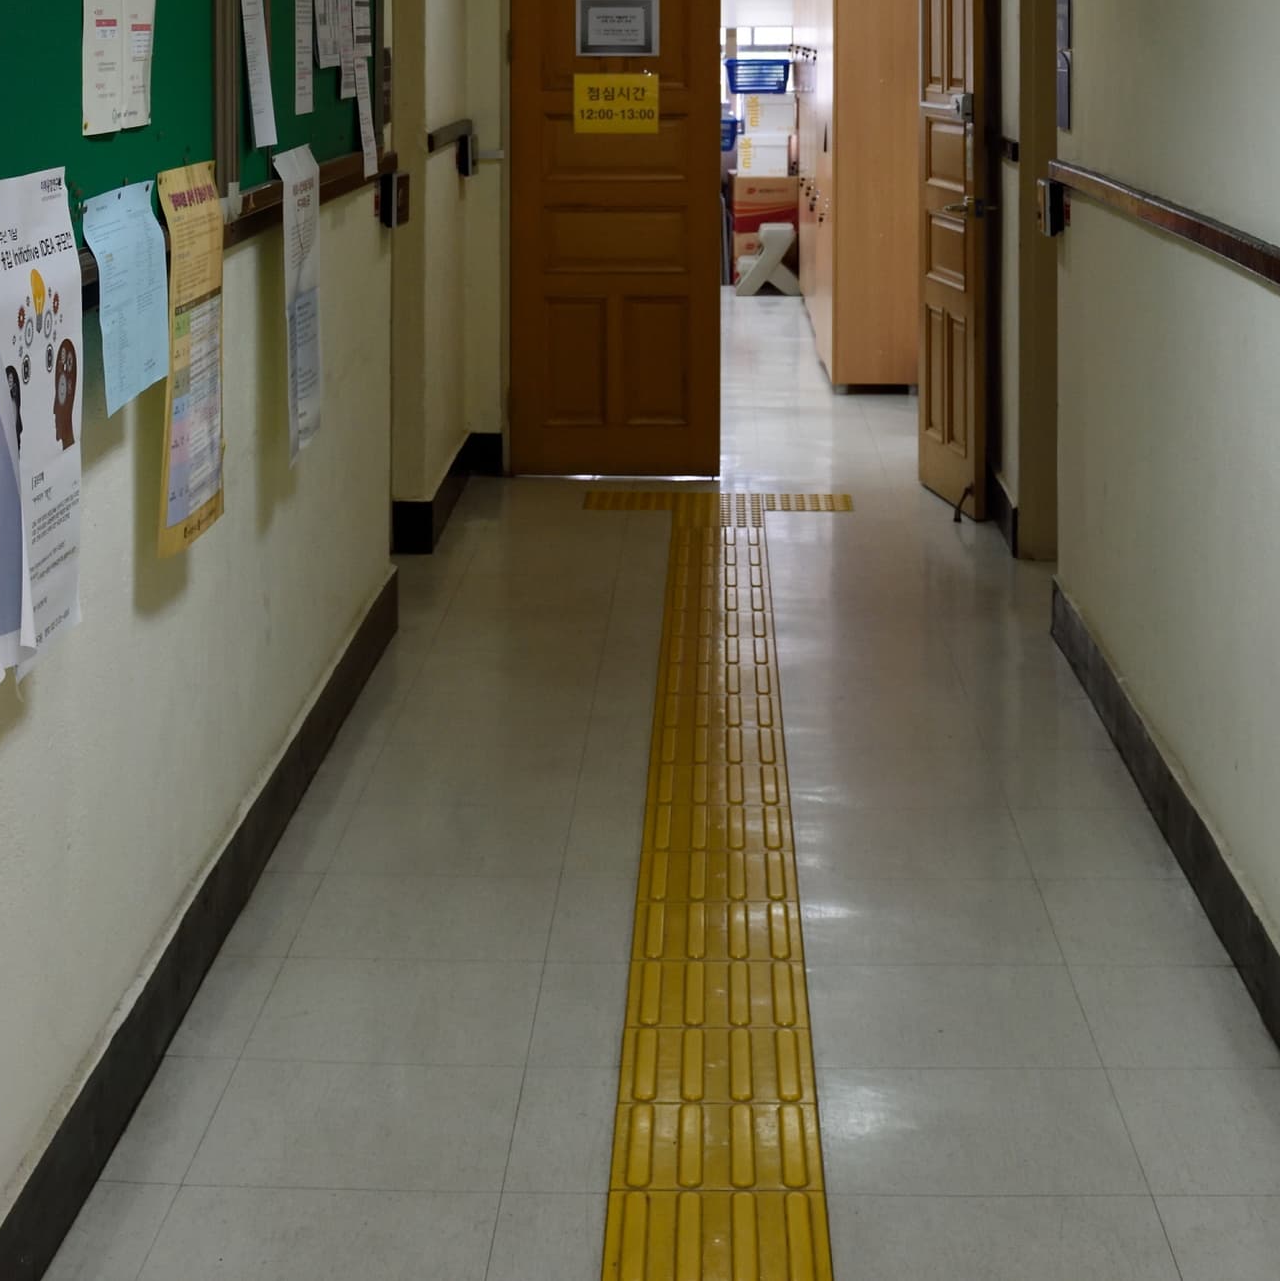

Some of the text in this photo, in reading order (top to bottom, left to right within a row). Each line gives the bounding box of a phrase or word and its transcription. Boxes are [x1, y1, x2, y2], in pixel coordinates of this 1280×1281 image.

[587, 86, 646, 101] 점심시간
[580, 109, 654, 120] 12:00-13:00
[748, 95, 759, 127] milk
[740, 137, 752, 169] milk
[12, 245, 40, 266] Initiative
[39, 237, 56, 258] IDEA
[54, 231, 73, 252] 공모전
